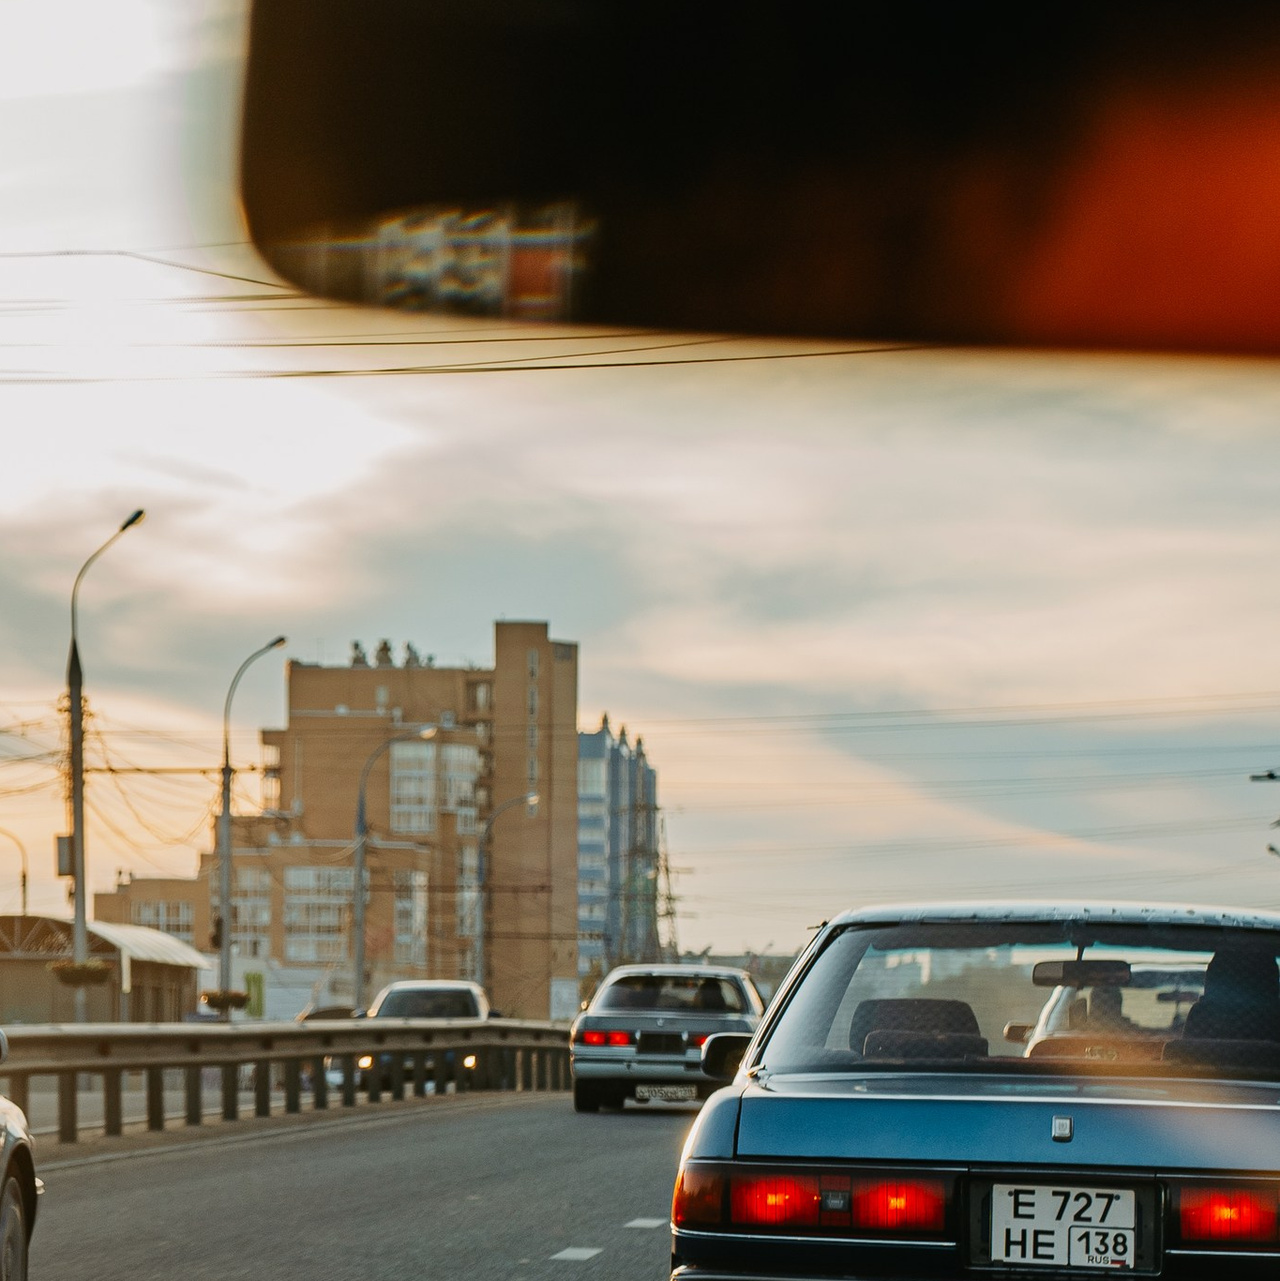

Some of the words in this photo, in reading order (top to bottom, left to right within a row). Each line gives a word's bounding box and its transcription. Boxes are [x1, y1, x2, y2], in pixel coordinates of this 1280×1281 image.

[1051, 1190, 1114, 1223] 727
[1077, 1231, 1128, 1256] 138
[1087, 1255, 1110, 1265] RUS
